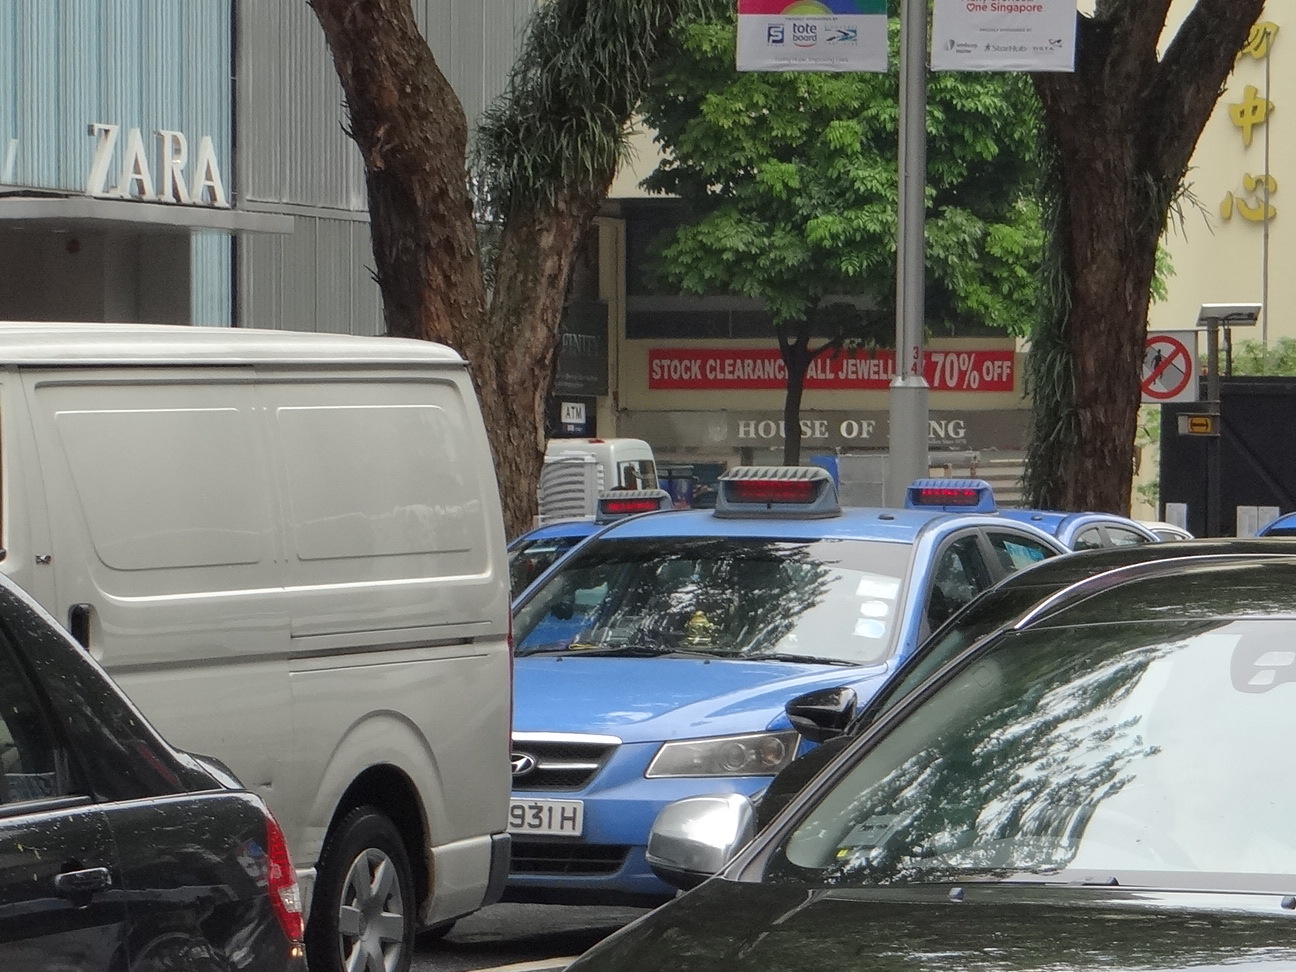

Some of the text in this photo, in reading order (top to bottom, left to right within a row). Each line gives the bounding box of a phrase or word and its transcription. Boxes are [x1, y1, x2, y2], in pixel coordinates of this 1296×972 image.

[991, 3, 1043, 13] Singapore
[792, 23, 817, 34] tote
[792, 34, 817, 42] board
[86, 123, 231, 209] ZARA
[652, 359, 701, 380] STOCK
[706, 359, 788, 380] CLEARANC
[807, 359, 834, 380] ALL
[931, 353, 980, 389] 70%
[982, 360, 1011, 382] OFF
[566, 405, 583, 420] ATM
[840, 420, 875, 438] OF
